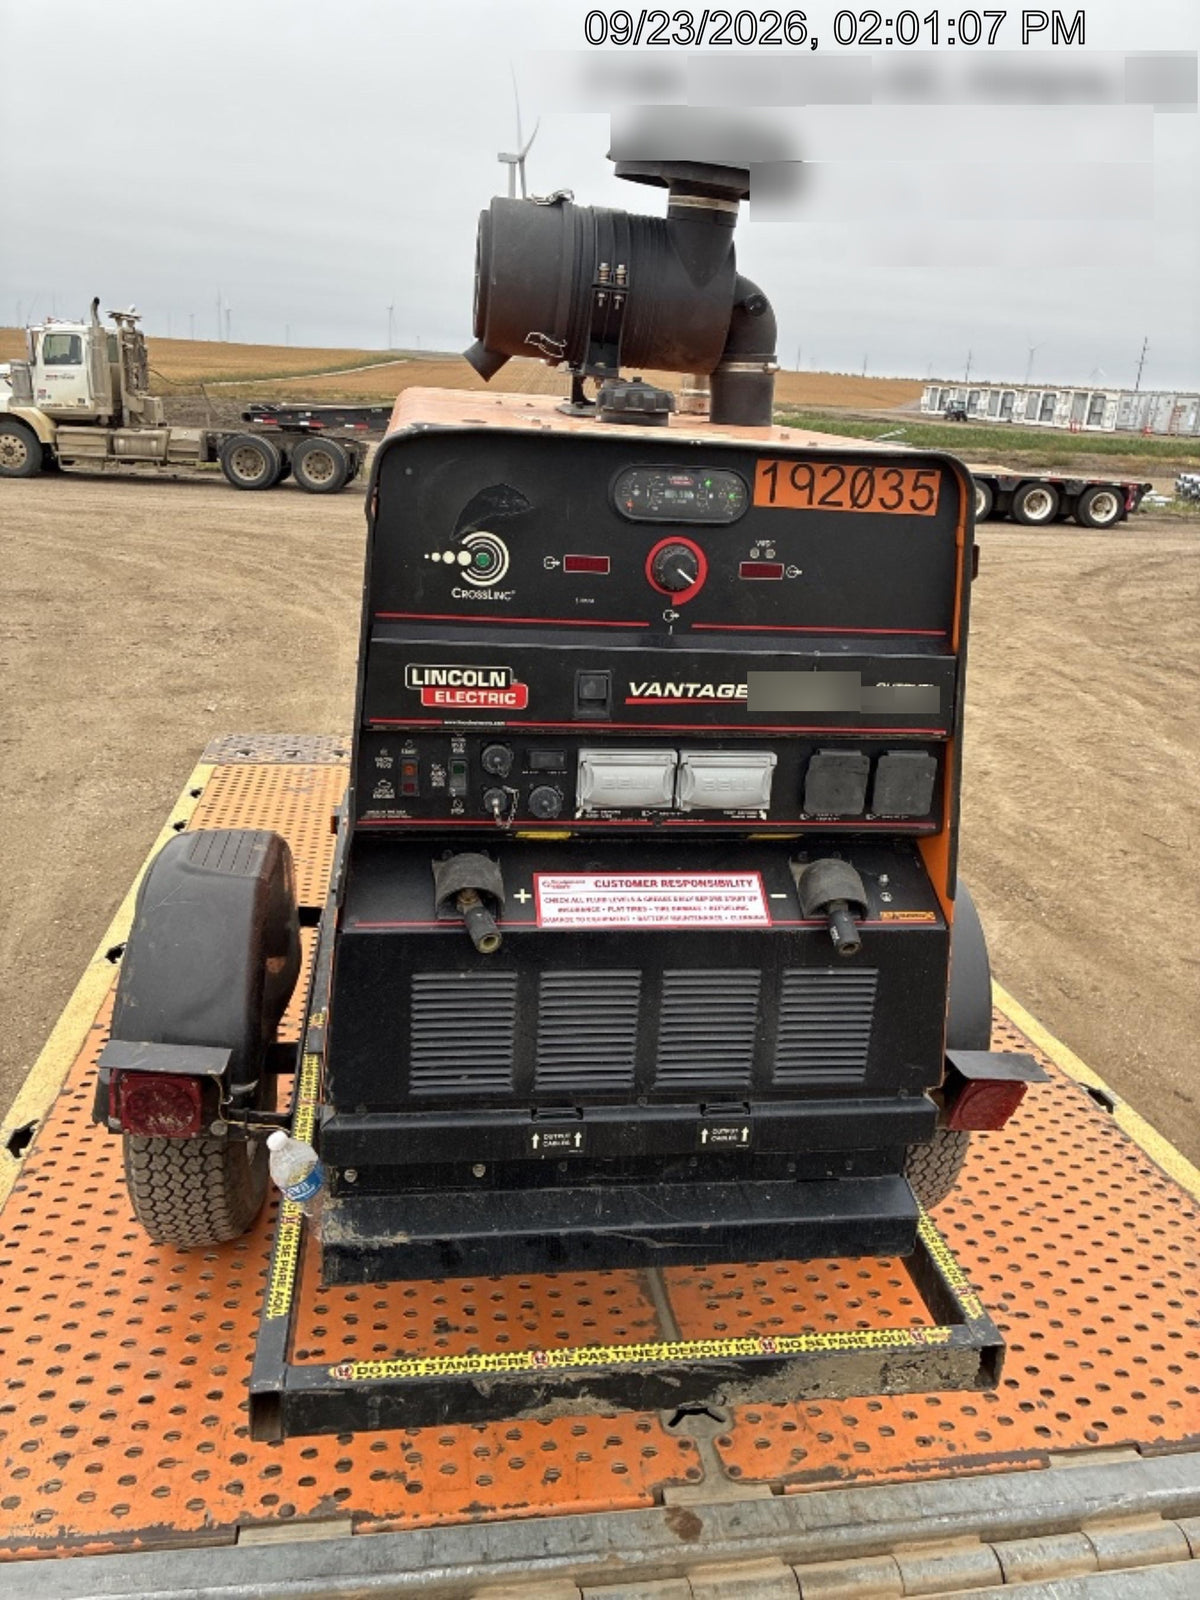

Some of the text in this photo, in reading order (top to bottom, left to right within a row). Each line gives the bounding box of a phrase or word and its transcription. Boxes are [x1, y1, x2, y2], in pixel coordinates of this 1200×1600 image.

[762, 461, 937, 512] 192035
[411, 669, 506, 687] LINCOLN
[435, 691, 517, 705] ELECTRIC
[629, 682, 748, 698] VANTAGE
[594, 879, 658, 888] CUSTOMER
[660, 879, 753, 888] RESPONSIBILITY
[283, 1228, 294, 1242] NO
[277, 1260, 289, 1288] PARE
[778, 1334, 908, 1351] NO SE PARE AQUI
[552, 1342, 756, 1364] NE PAS TENEZ DEBOUT ICI
[356, 1356, 529, 1376] DO NOT STAND HERE
